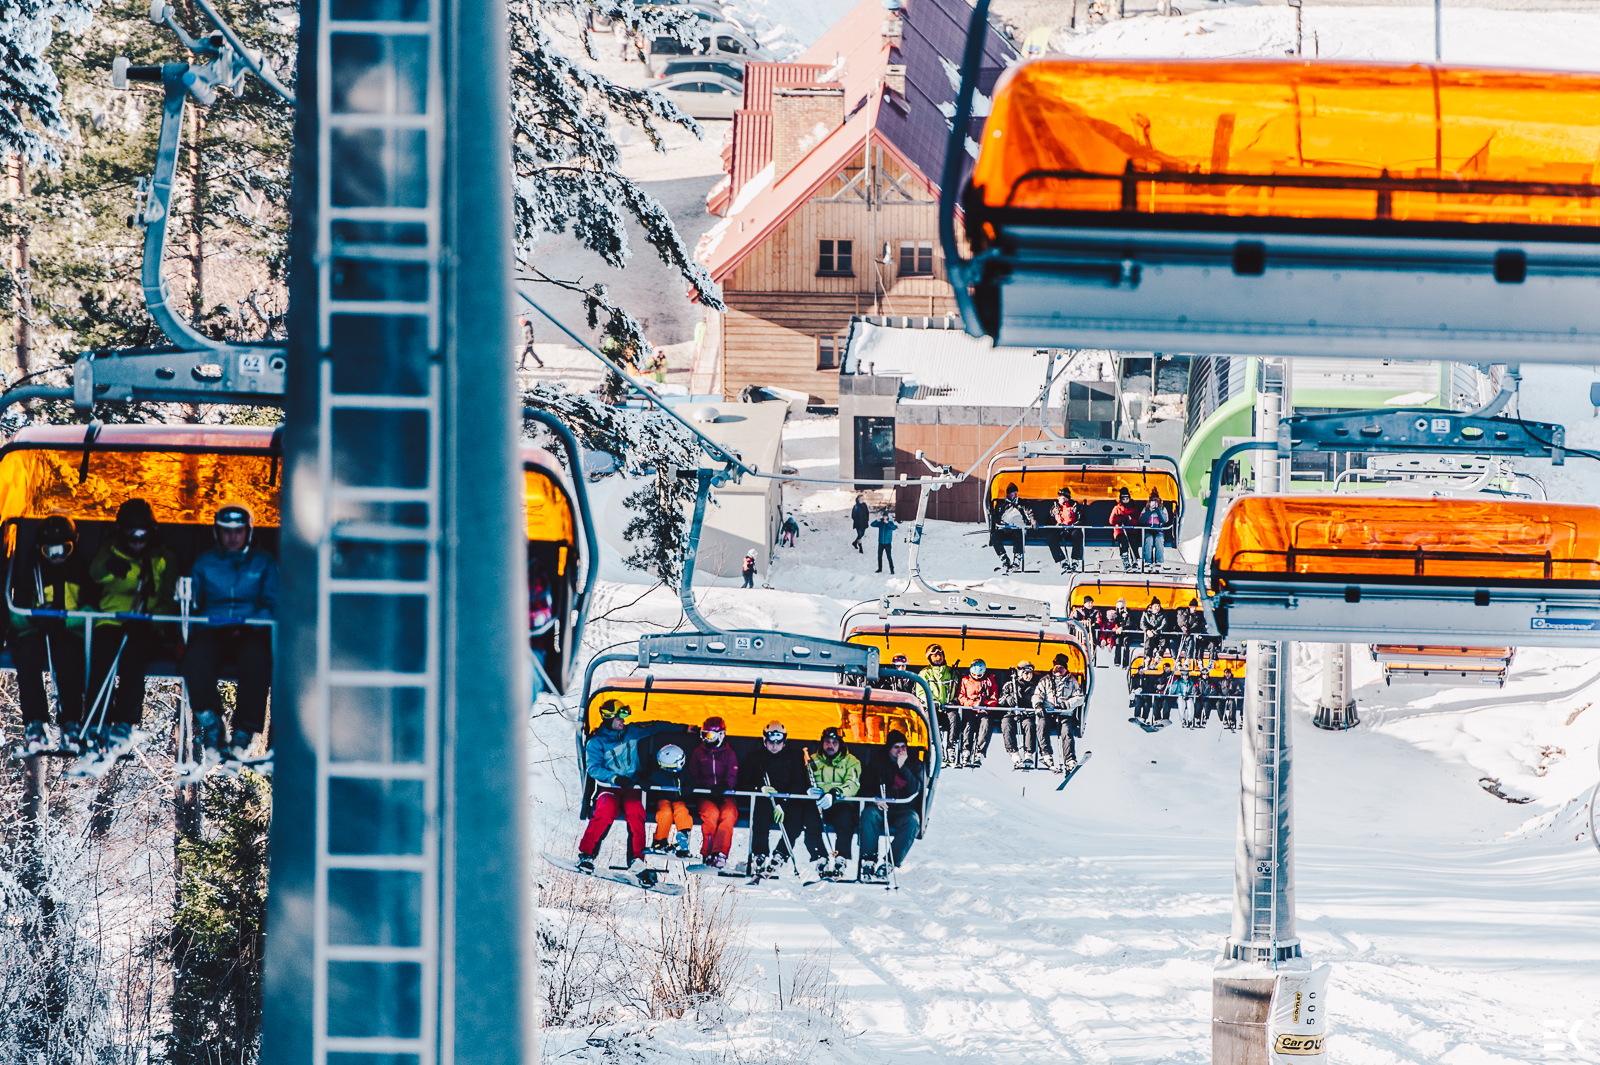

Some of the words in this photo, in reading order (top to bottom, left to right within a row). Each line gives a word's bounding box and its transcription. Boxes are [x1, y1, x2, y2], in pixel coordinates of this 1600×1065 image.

[243, 356, 260, 367] 62
[1435, 420, 1447, 428] 13
[737, 638, 748, 646] 63
